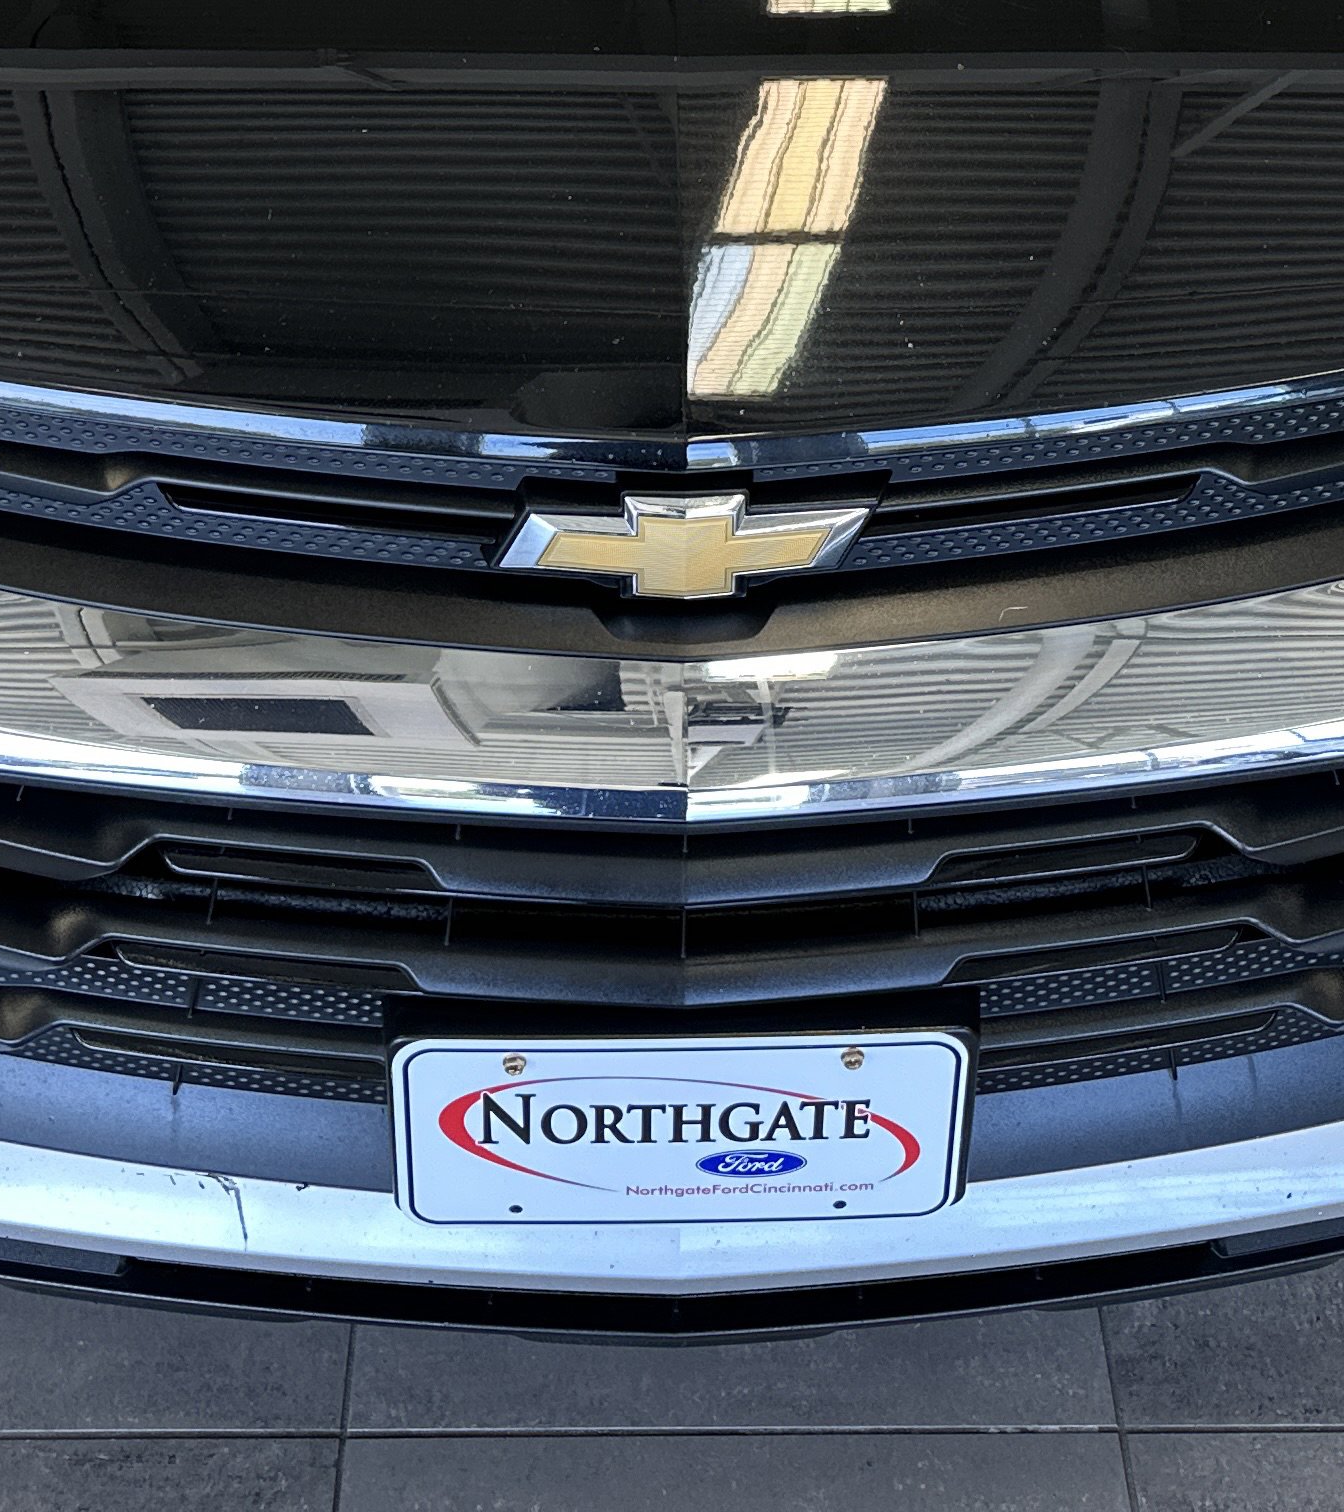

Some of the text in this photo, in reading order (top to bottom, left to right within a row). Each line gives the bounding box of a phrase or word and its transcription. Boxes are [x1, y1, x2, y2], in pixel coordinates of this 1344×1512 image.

[477, 1092, 871, 1145] NORTHGATE
[717, 1152, 785, 1173] Ford
[625, 1182, 874, 1198] NorthgateFordCincinnati.com
